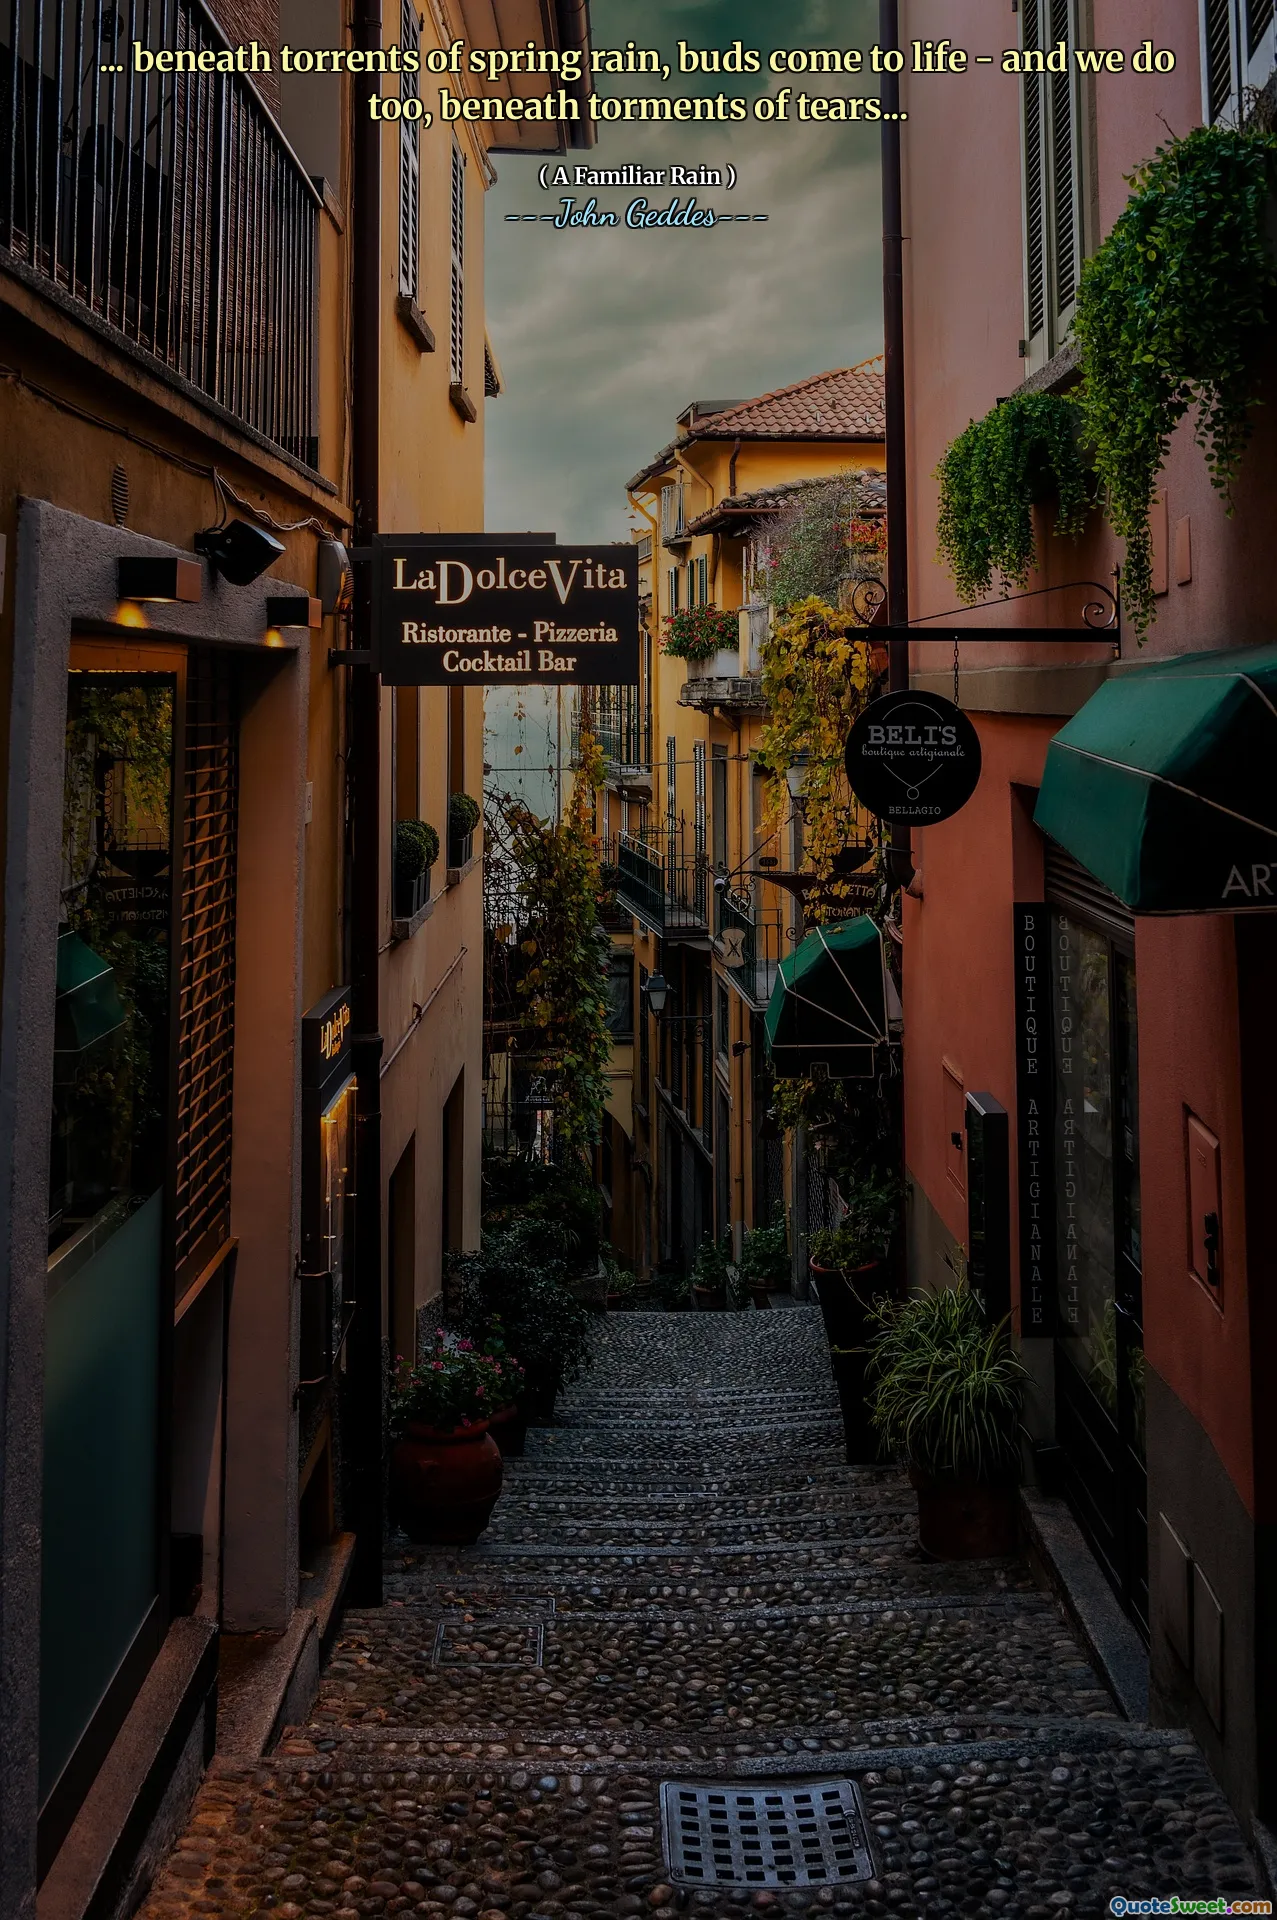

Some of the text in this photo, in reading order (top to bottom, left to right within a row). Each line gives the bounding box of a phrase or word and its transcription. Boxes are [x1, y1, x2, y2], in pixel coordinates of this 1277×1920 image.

[402, 622, 511, 643] Ristorante
[533, 621, 618, 643] Pizzeria
[443, 650, 577, 672] Cocktail Bar
[867, 725, 957, 746] BELI'S
[861, 744, 966, 762] boutique artigianale
[888, 806, 942, 815] BELLAGIO
[1023, 915, 1043, 1324] BOUTIQUE ARTIGIANALE
